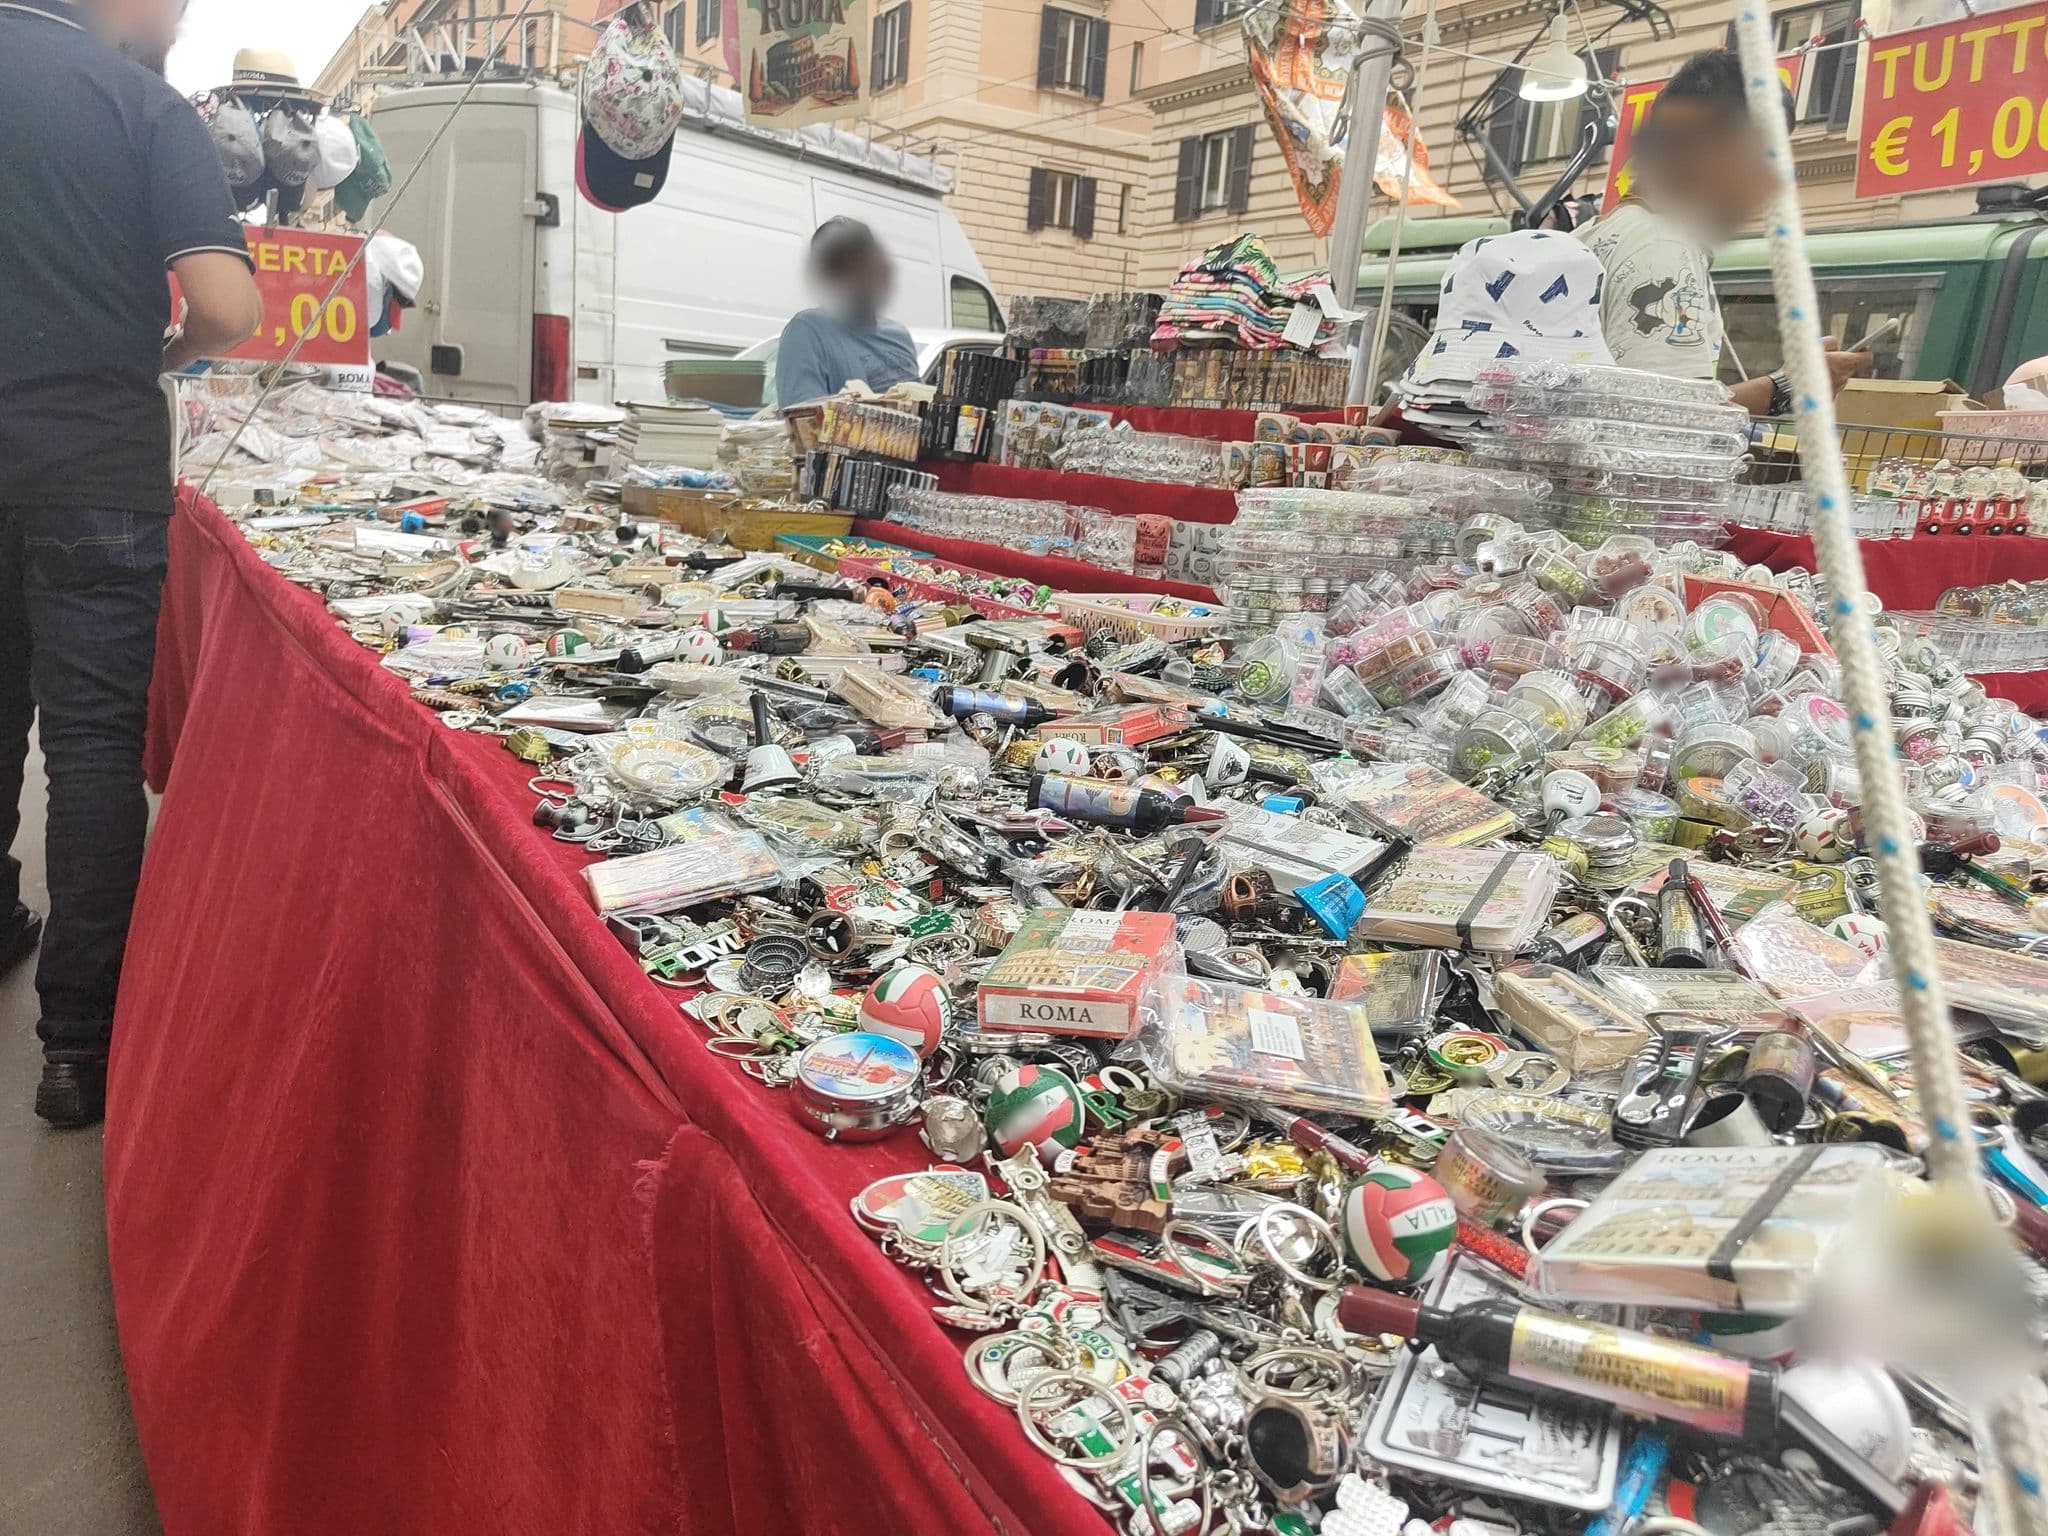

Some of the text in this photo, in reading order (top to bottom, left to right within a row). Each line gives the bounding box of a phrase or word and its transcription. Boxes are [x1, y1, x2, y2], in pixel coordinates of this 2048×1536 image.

[1873, 16, 2048, 100] TUTT
[1870, 116, 1913, 176] €
[253, 292, 357, 347] ,00
[1399, 870, 1472, 882] ROMA
[1070, 916, 1124, 927] ROMA
[1021, 1003, 1094, 1024] ROMA
[1657, 1154, 1758, 1164] ROMA
